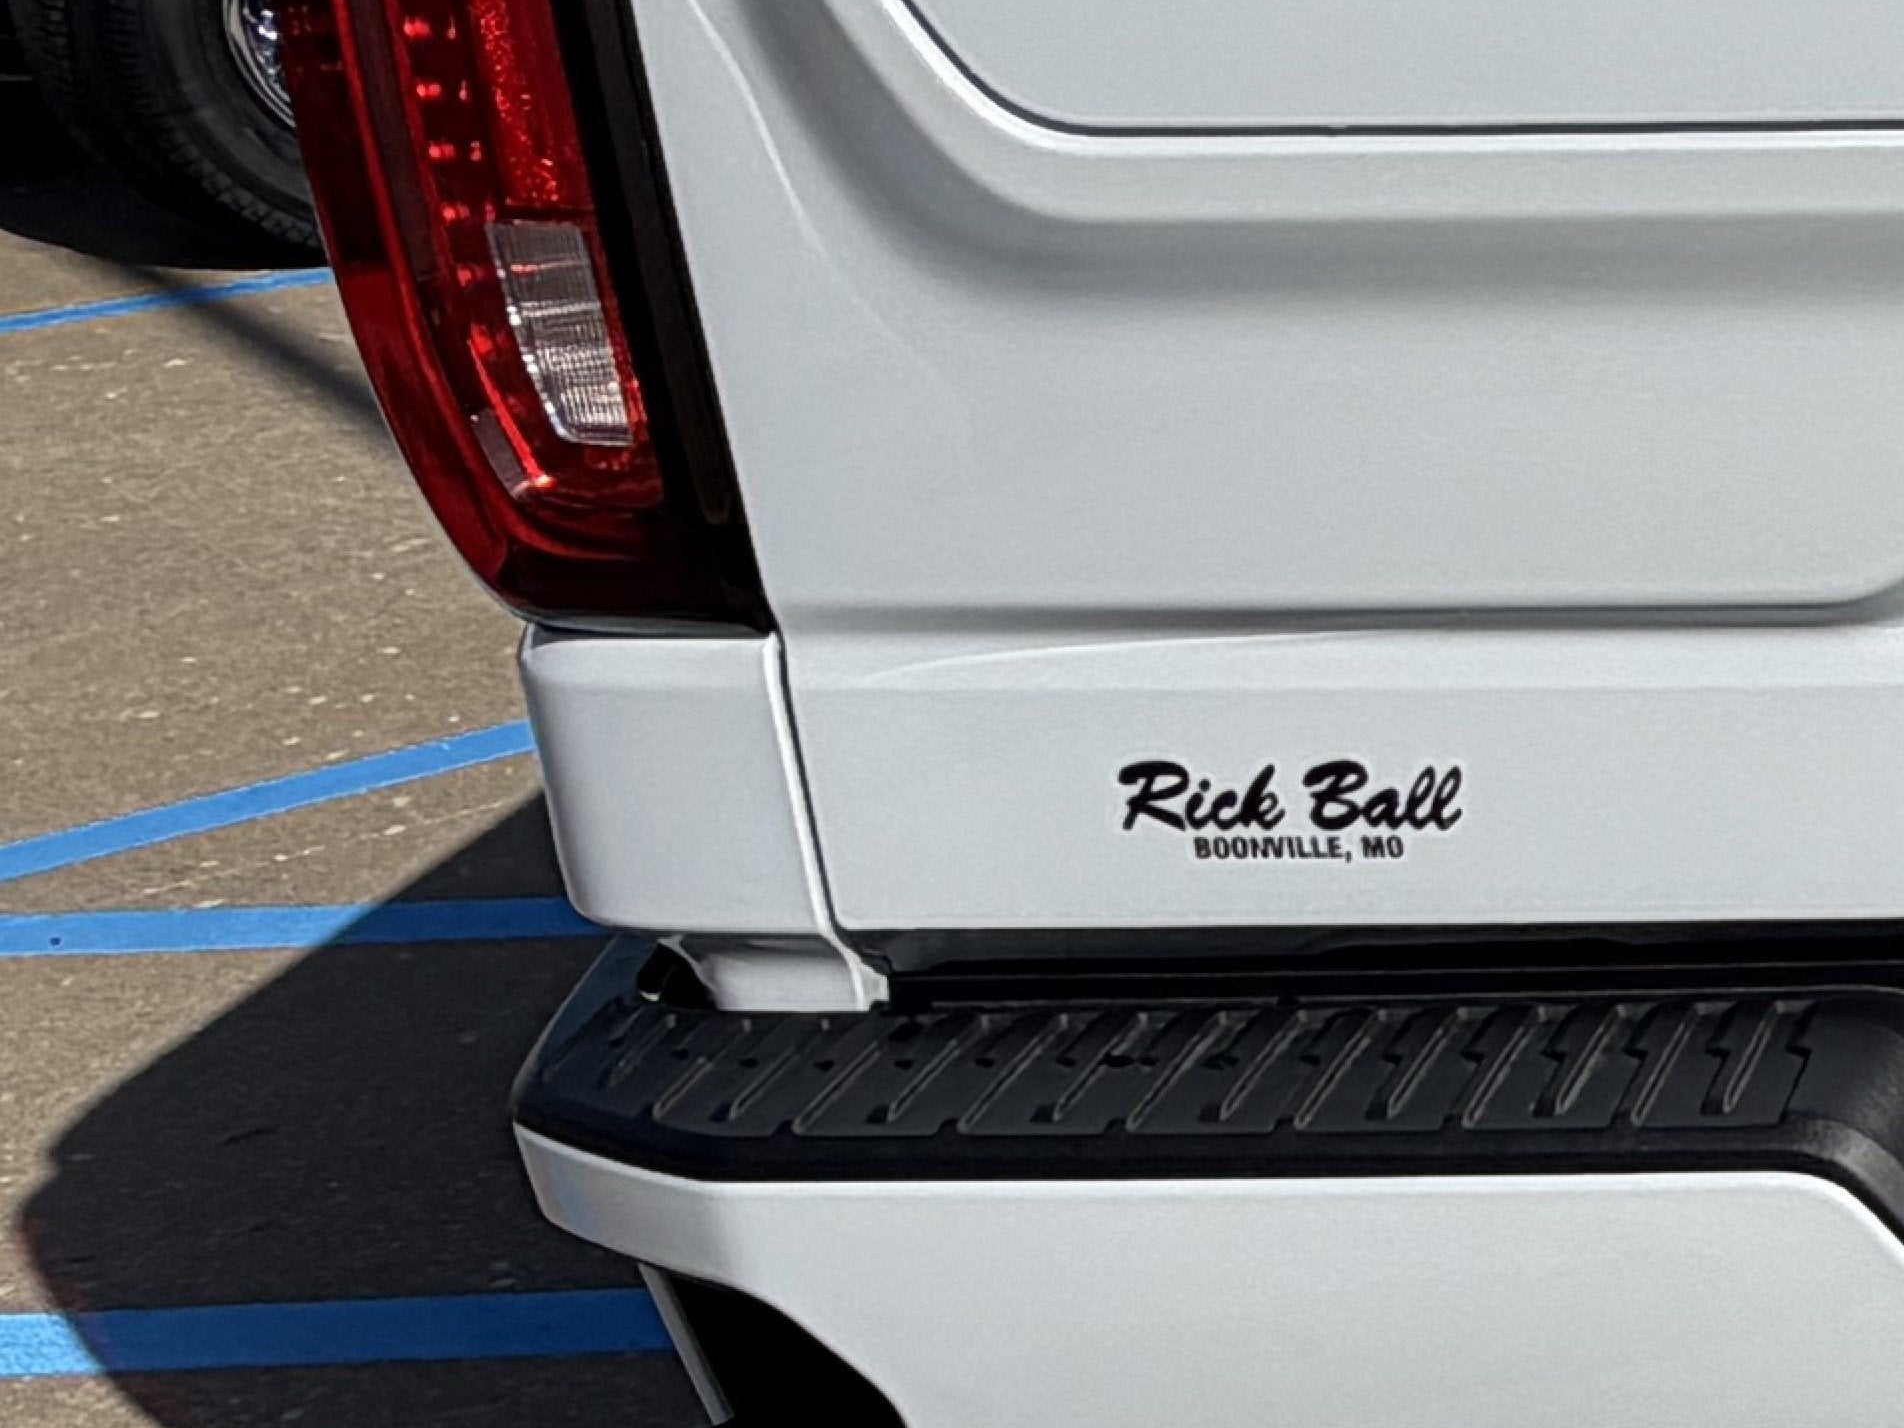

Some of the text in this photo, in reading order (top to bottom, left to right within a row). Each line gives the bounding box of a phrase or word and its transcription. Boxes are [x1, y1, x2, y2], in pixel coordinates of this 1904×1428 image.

[1117, 759, 1463, 831] Rick Ball
[1193, 835, 1404, 864] BOONVILLE, MO
